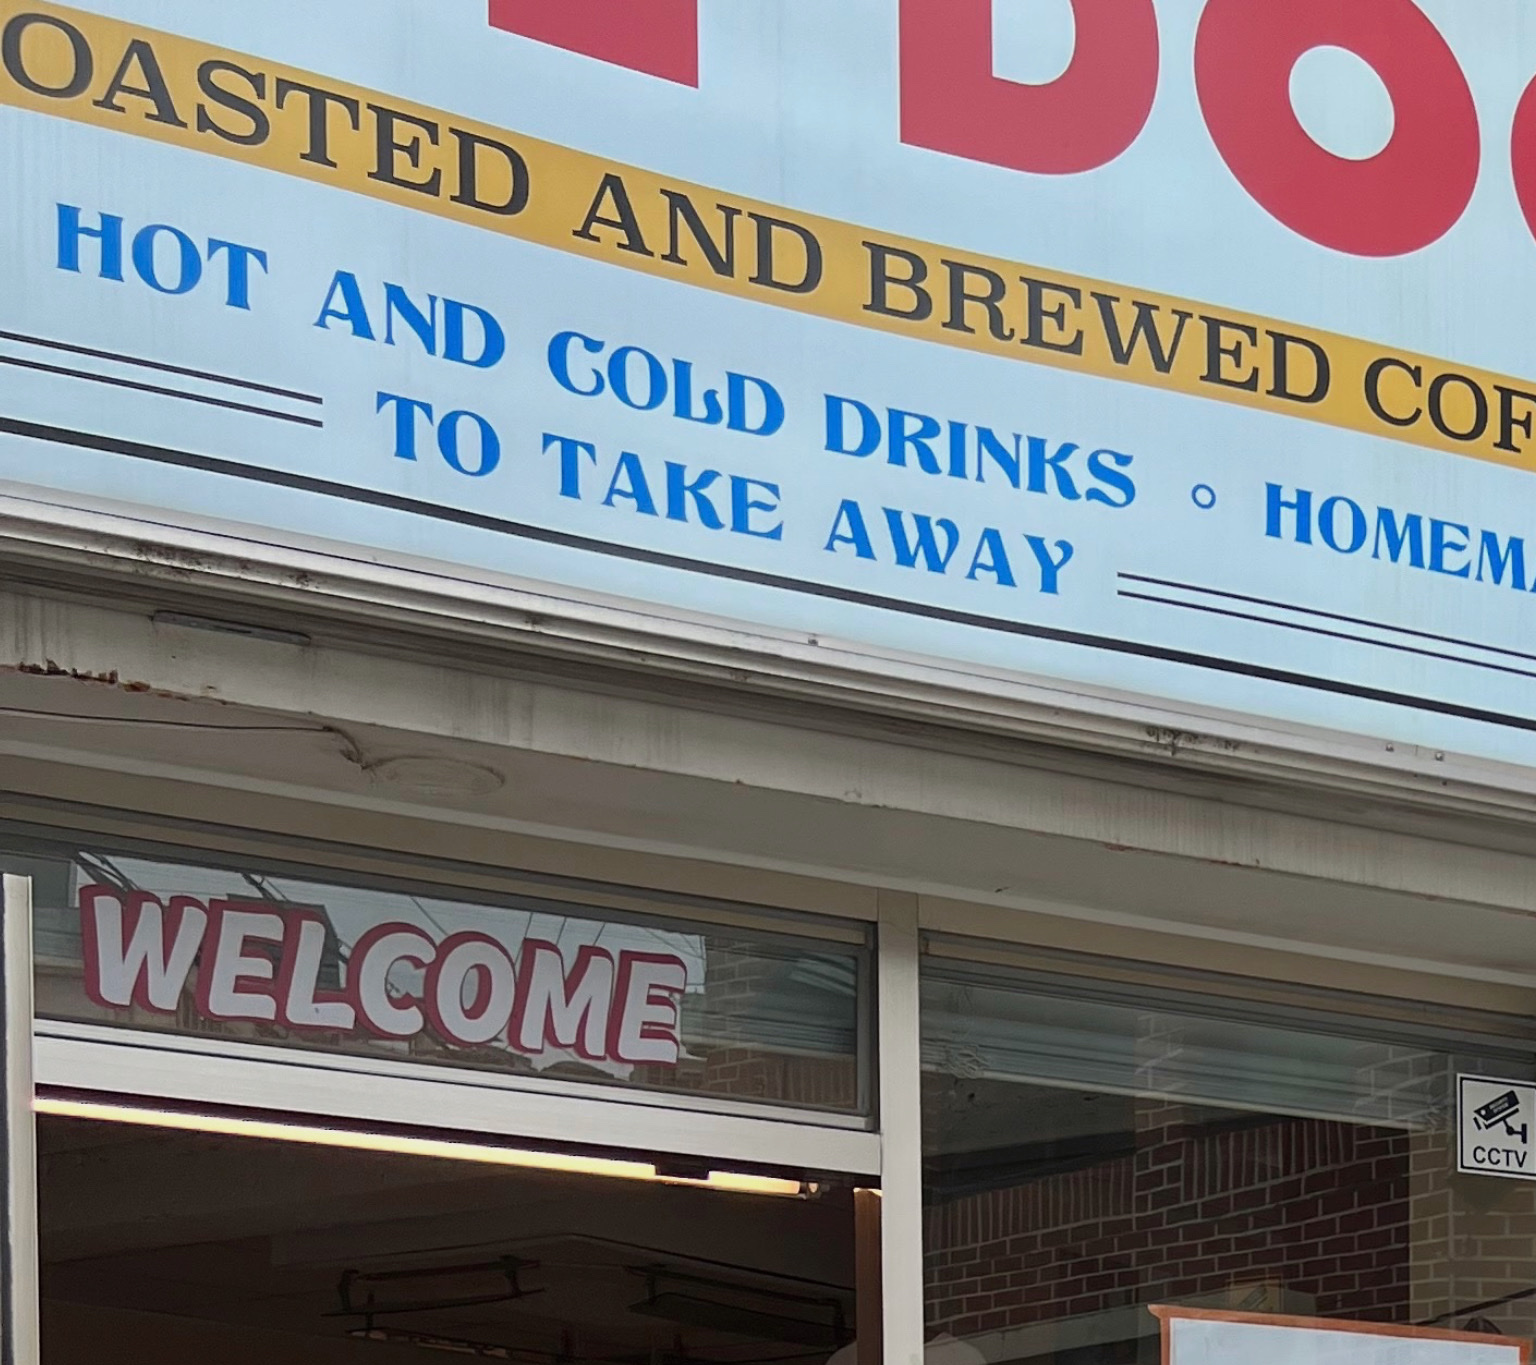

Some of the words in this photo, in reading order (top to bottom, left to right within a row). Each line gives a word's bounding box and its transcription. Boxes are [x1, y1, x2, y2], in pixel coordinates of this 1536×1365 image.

[55, 203, 268, 311] HOT
[313, 270, 506, 370] AND
[547, 330, 786, 439] COLD
[823, 393, 1137, 509] DRINKS
[573, 171, 823, 296] AND
[861, 240, 1332, 405] BREWED
[376, 390, 501, 477] TO
[541, 432, 784, 541] TAKE
[823, 500, 1073, 595] AWAY
[79, 885, 688, 1065] WELCOME
[1473, 1145, 1527, 1168] CCTV
